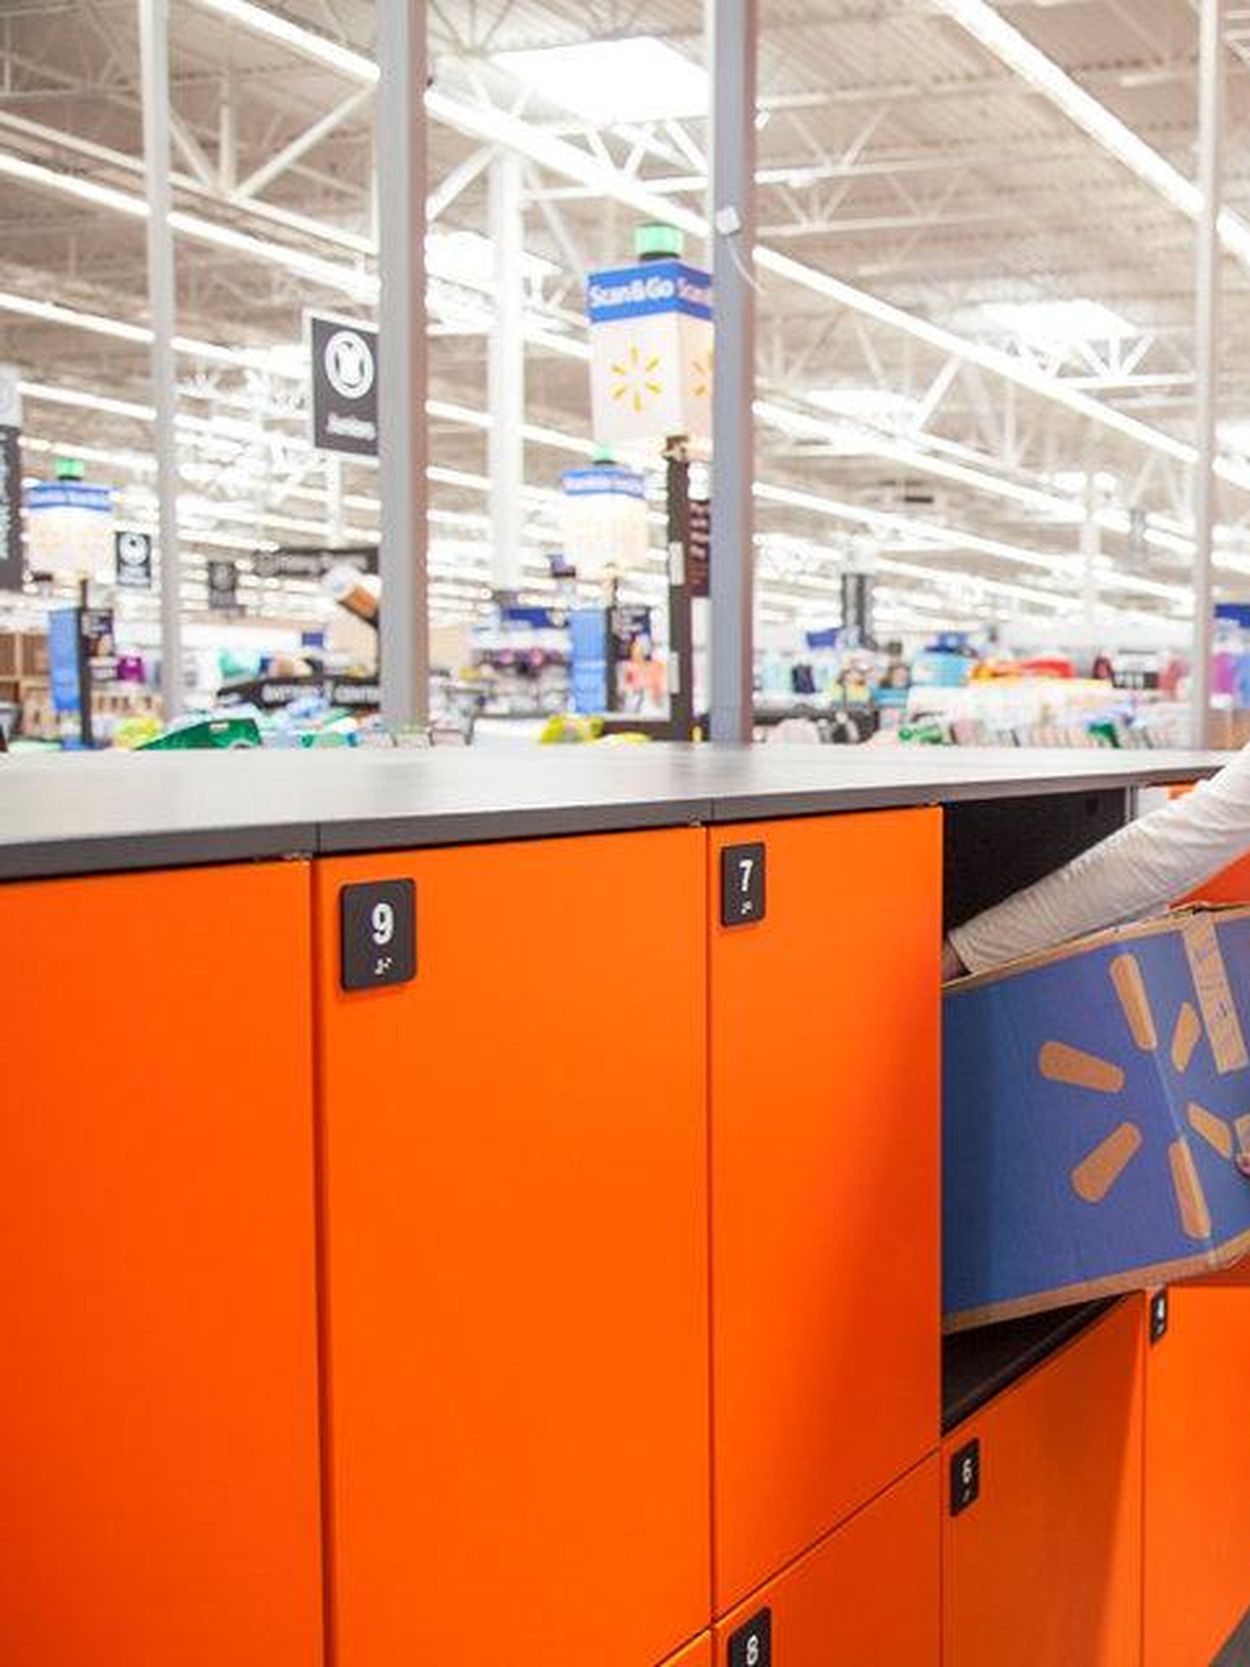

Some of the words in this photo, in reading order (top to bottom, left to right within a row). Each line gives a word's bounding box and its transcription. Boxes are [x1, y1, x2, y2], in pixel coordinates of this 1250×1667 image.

[739, 859, 754, 892] 7
[372, 902, 394, 945] 9
[962, 1458, 973, 1485] 6
[746, 1634, 759, 1666] 8
